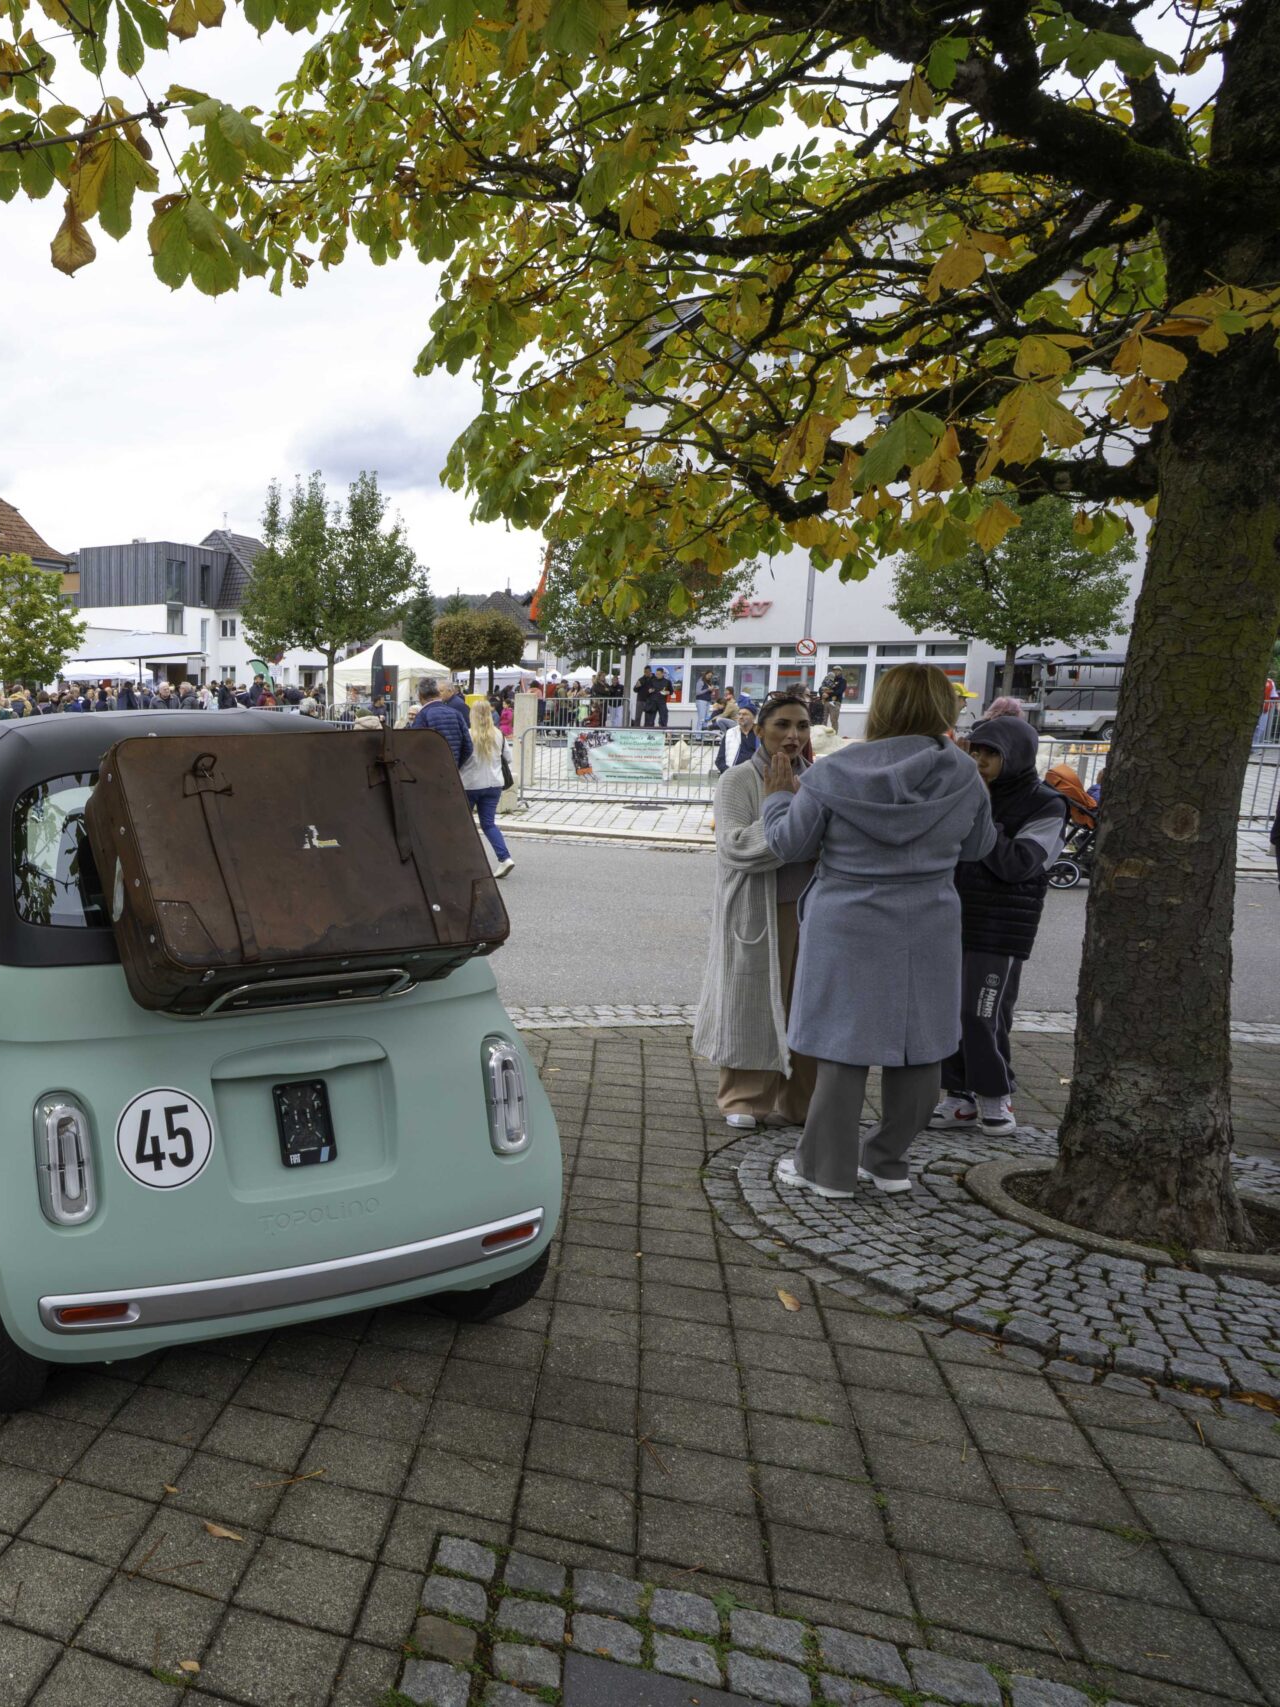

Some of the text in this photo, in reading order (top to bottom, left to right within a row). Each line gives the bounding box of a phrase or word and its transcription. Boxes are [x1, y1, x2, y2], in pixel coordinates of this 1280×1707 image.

[981, 988, 997, 1018] PARIS
[135, 1104, 195, 1172] 45
[289, 1153, 301, 1165] FIAT
